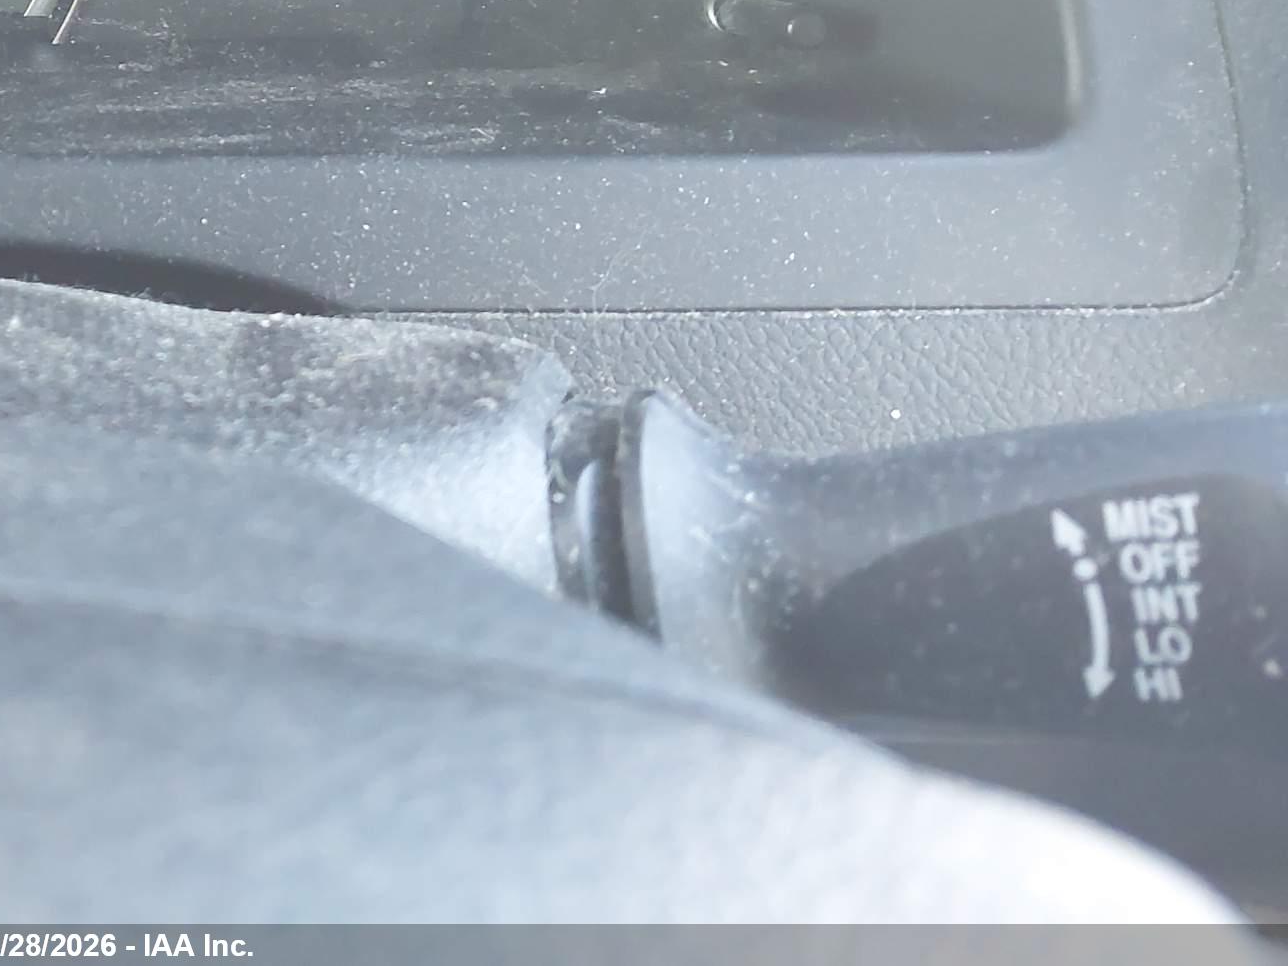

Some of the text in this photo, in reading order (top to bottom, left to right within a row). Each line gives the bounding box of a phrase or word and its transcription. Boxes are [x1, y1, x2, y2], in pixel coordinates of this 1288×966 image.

[1102, 493, 1201, 542] MIST
[1118, 537, 1202, 584] OFF
[1130, 582, 1203, 624] INT
[1133, 625, 1194, 665] LO
[1132, 666, 1184, 702] HI
